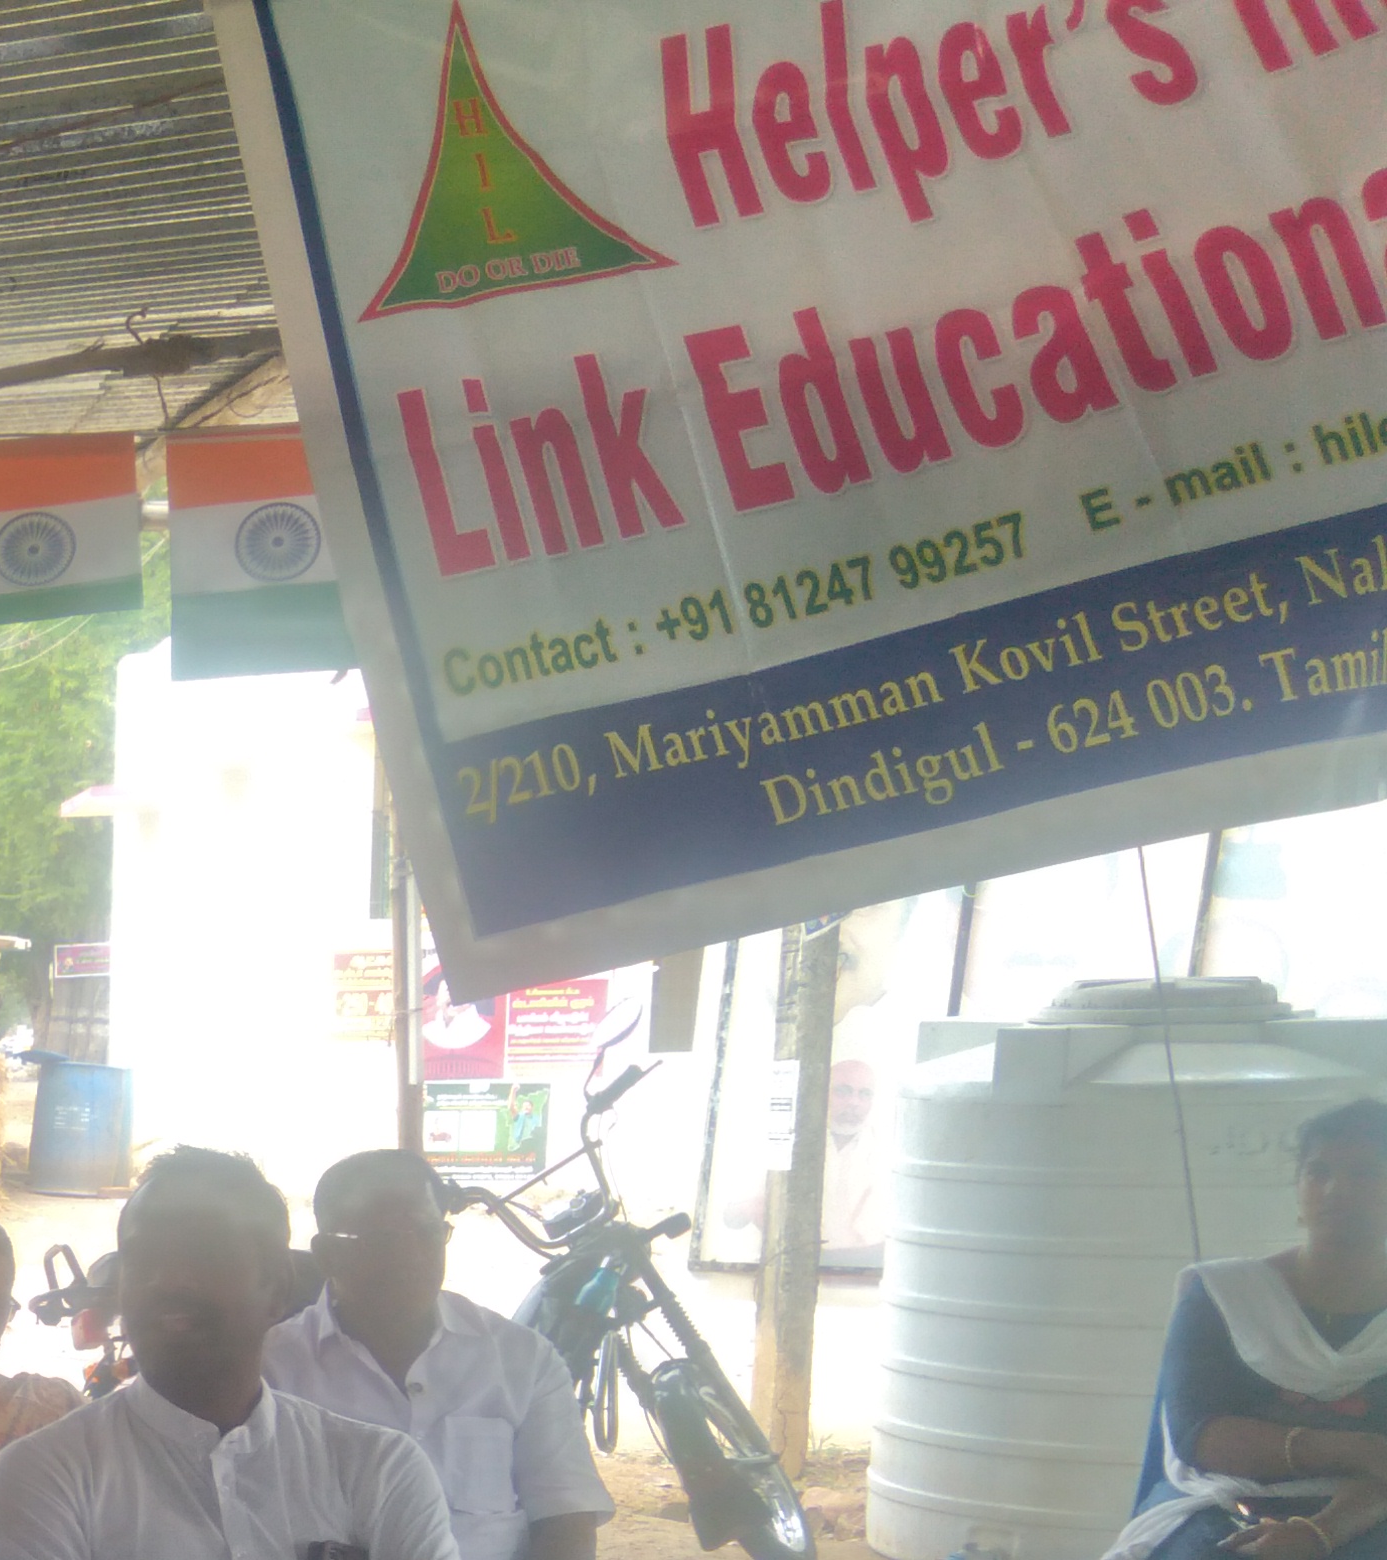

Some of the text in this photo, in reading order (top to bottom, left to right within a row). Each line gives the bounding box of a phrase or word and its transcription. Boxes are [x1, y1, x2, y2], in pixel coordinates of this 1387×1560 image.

[660, 0, 1199, 226] Helper's
[435, 246, 581, 293] DO OR DIE
[396, 354, 687, 578] Link
[1164, 441, 1275, 507] mail
[443, 616, 618, 697] Contact
[656, 587, 735, 644] +91
[747, 554, 876, 630] 81247
[887, 510, 1027, 592] 99257
[457, 742, 598, 826] 2/210,
[603, 668, 945, 779] Mariyamman
[948, 611, 1103, 695] Kovil
[1111, 571, 1290, 653] Street,
[759, 723, 1004, 827] Dindigul
[1046, 689, 1140, 754] 624
[1146, 663, 1254, 730] 003.
